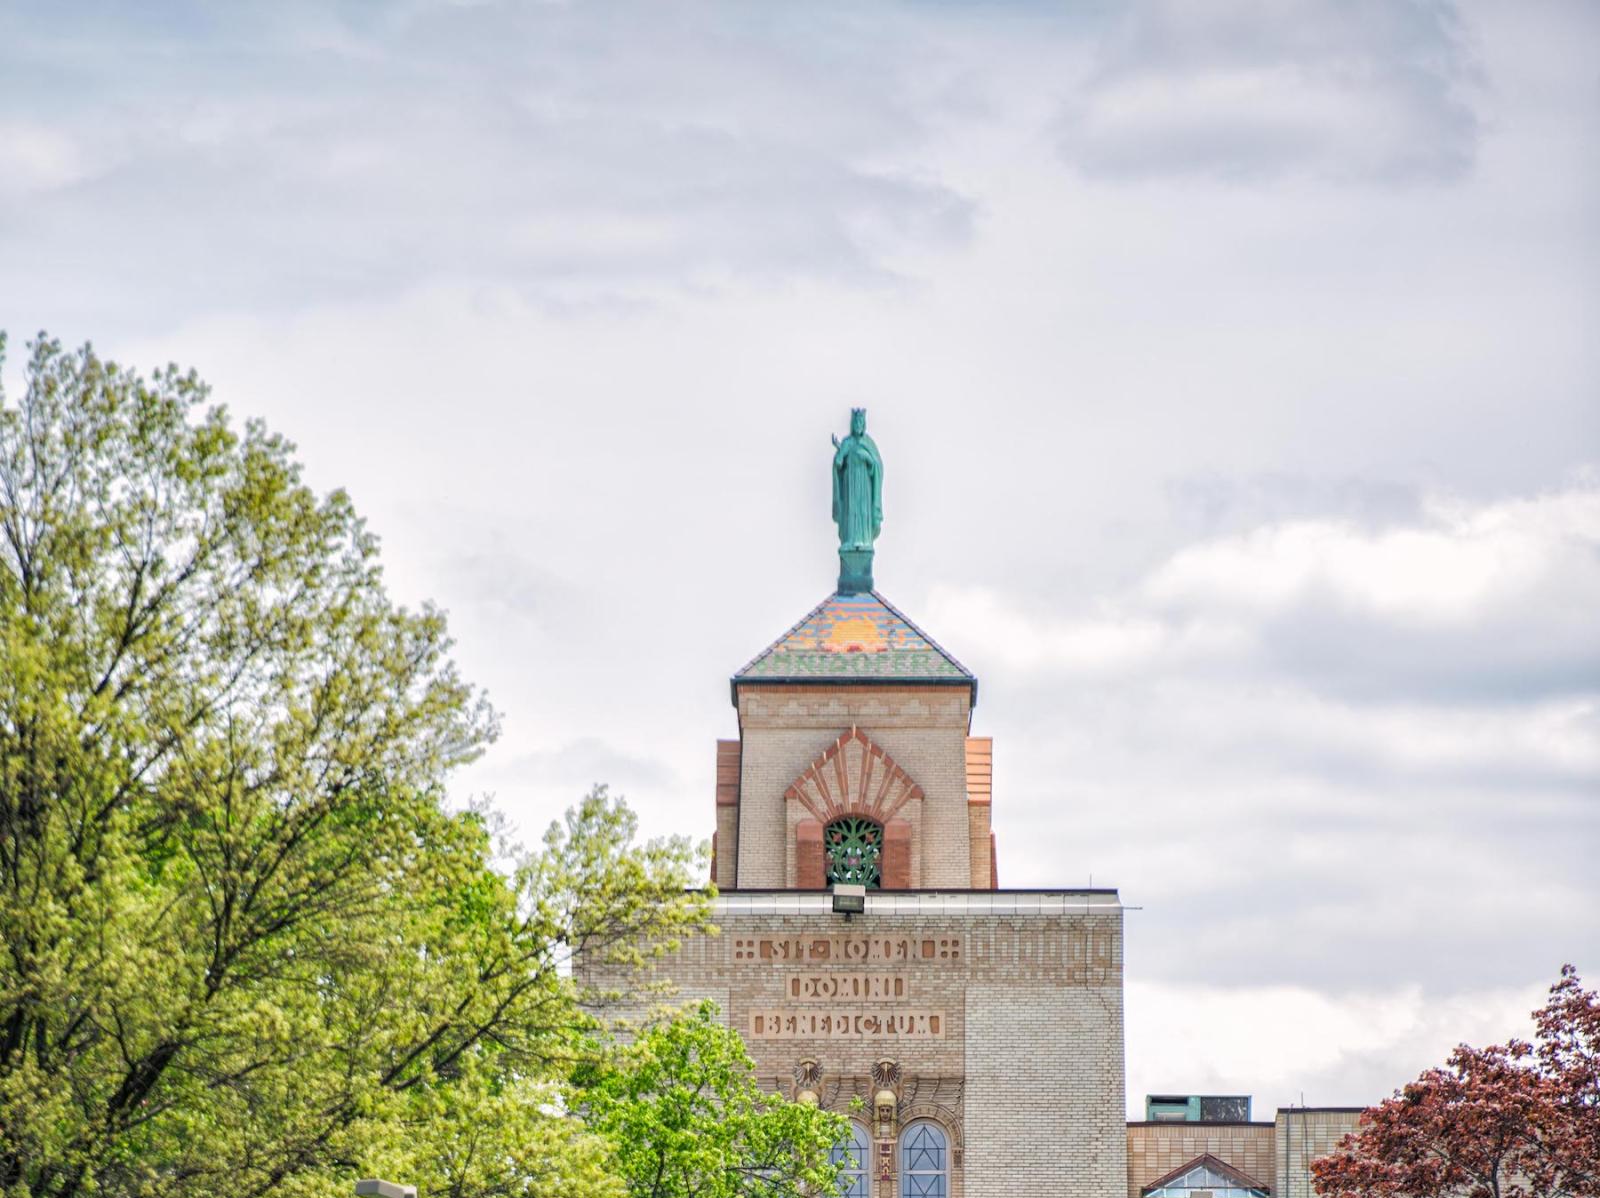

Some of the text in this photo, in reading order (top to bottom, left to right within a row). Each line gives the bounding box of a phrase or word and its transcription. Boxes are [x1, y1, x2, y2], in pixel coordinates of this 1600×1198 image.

[830, 940, 922, 959] NOMEN
[799, 978, 895, 997] DOMINI
[763, 1015, 930, 1034] BENEDICTUM
